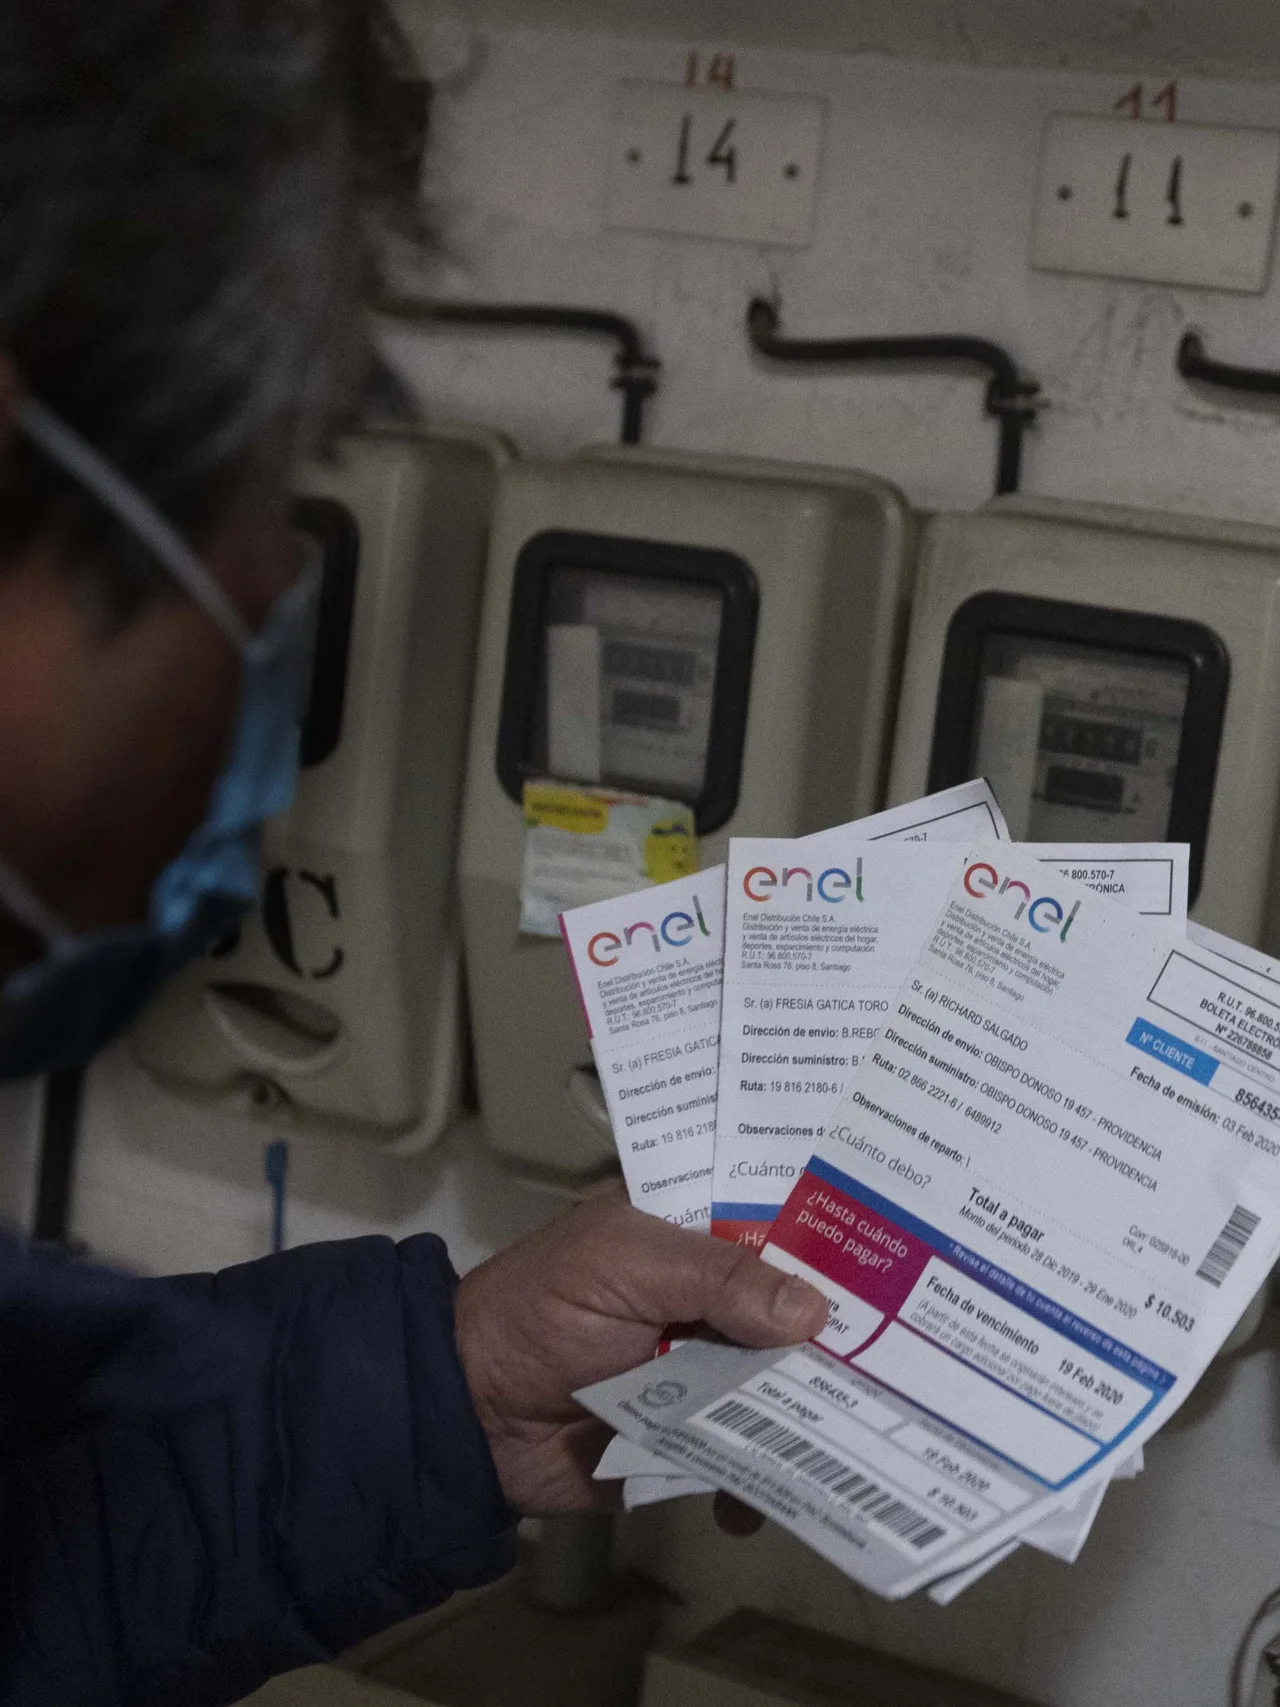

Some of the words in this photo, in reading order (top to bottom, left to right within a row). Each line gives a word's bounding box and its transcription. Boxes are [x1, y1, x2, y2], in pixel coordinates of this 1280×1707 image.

[673, 113, 737, 184] 14
[1112, 152, 1184, 227] 11
[743, 857, 866, 903] enel
[964, 861, 1082, 943] enel
[588, 895, 711, 967] enel
[744, 997, 756, 1008] Sr.
[759, 998, 773, 1011] (a)
[775, 998, 813, 1010] FRESIA
[816, 998, 855, 1011] GATICA
[858, 1000, 889, 1012] TORO
[911, 979, 924, 994] Sr.
[924, 987, 939, 1004] (a)
[938, 994, 983, 1026] RICHARD
[982, 1019, 1028, 1051] SALGADO
[1199, 998, 1236, 1026] BOLETA
[1217, 991, 1243, 1013] R.U.T.
[742, 1024, 790, 1036] Dirección
[793, 1026, 806, 1037] de
[611, 1062, 627, 1074] Sr.
[628, 1057, 642, 1072] (a)
[643, 1046, 683, 1065] FRESIA
[741, 1052, 787, 1064] Dirección
[792, 1054, 848, 1066] suministro:
[1152, 1039, 1195, 1070] CLIENTE
[618, 1079, 667, 1100] Dirección
[669, 1075, 682, 1086] de
[740, 1080, 766, 1092] Ruta:
[770, 1080, 781, 1092] 19
[784, 1081, 802, 1093] 816
[804, 1081, 838, 1094] 2180-6
[872, 1052, 898, 1074] Ruta:
[897, 1067, 911, 1082] 02
[910, 1074, 928, 1091] 866
[926, 1084, 958, 1108] 2221-6
[964, 1106, 1002, 1134] 6489912
[898, 1004, 941, 1035] Dirección
[941, 1030, 954, 1042] de
[984, 1052, 1020, 1079] OBISPO
[1020, 1072, 1063, 1103] DONOSO
[1063, 1097, 1075, 1110] 19
[1074, 1104, 1093, 1120] 457
[1097, 1116, 1162, 1162] PROVIDENCIA
[625, 1106, 674, 1127] Dirección
[738, 1123, 813, 1136] Observaciones
[852, 1091, 918, 1136] Observaciones
[918, 1131, 930, 1144] de
[930, 1139, 962, 1164] reparto:
[884, 1028, 928, 1060] Dirección
[928, 1055, 979, 1089] suministro:
[980, 1082, 1016, 1110] OBISPO
[1015, 1102, 1058, 1134] DONOSO
[1058, 1128, 1071, 1141] 19
[1070, 1135, 1089, 1150] 457
[1092, 1147, 1158, 1192] PROVIDENCIA
[1130, 1066, 1161, 1091] Fecha
[1162, 1085, 1176, 1099] de
[1176, 1094, 1220, 1124] emisión:
[1222, 1116, 1237, 1133] 03
[1235, 1124, 1254, 1143] Feb
[1254, 1134, 1280, 1157] 2020
[631, 1139, 658, 1153] Ruta:
[661, 1132, 674, 1144] 19
[675, 1126, 694, 1140] 816
[829, 1125, 886, 1163] ¿Cuánto
[888, 1157, 932, 1189] debo?
[640, 1165, 714, 1194] Observacione
[729, 1160, 795, 1179] ¿Cuánto
[806, 1191, 856, 1226] ¿Hasta
[857, 1220, 908, 1258] cuándo
[969, 1187, 1000, 1216] Total
[999, 1210, 1008, 1221] a
[1006, 1215, 1045, 1242] pagar
[795, 1209, 844, 1244] puedo
[842, 1238, 893, 1273] pagar?
[926, 1275, 960, 1306] Fecha
[960, 1298, 975, 1314] de
[976, 1308, 1039, 1354] vencimiento
[1144, 1294, 1156, 1309] $
[1156, 1301, 1195, 1333] 10.503
[1058, 1359, 1074, 1375] 19
[1072, 1367, 1095, 1389] Feb
[1094, 1381, 1124, 1405] 2020
